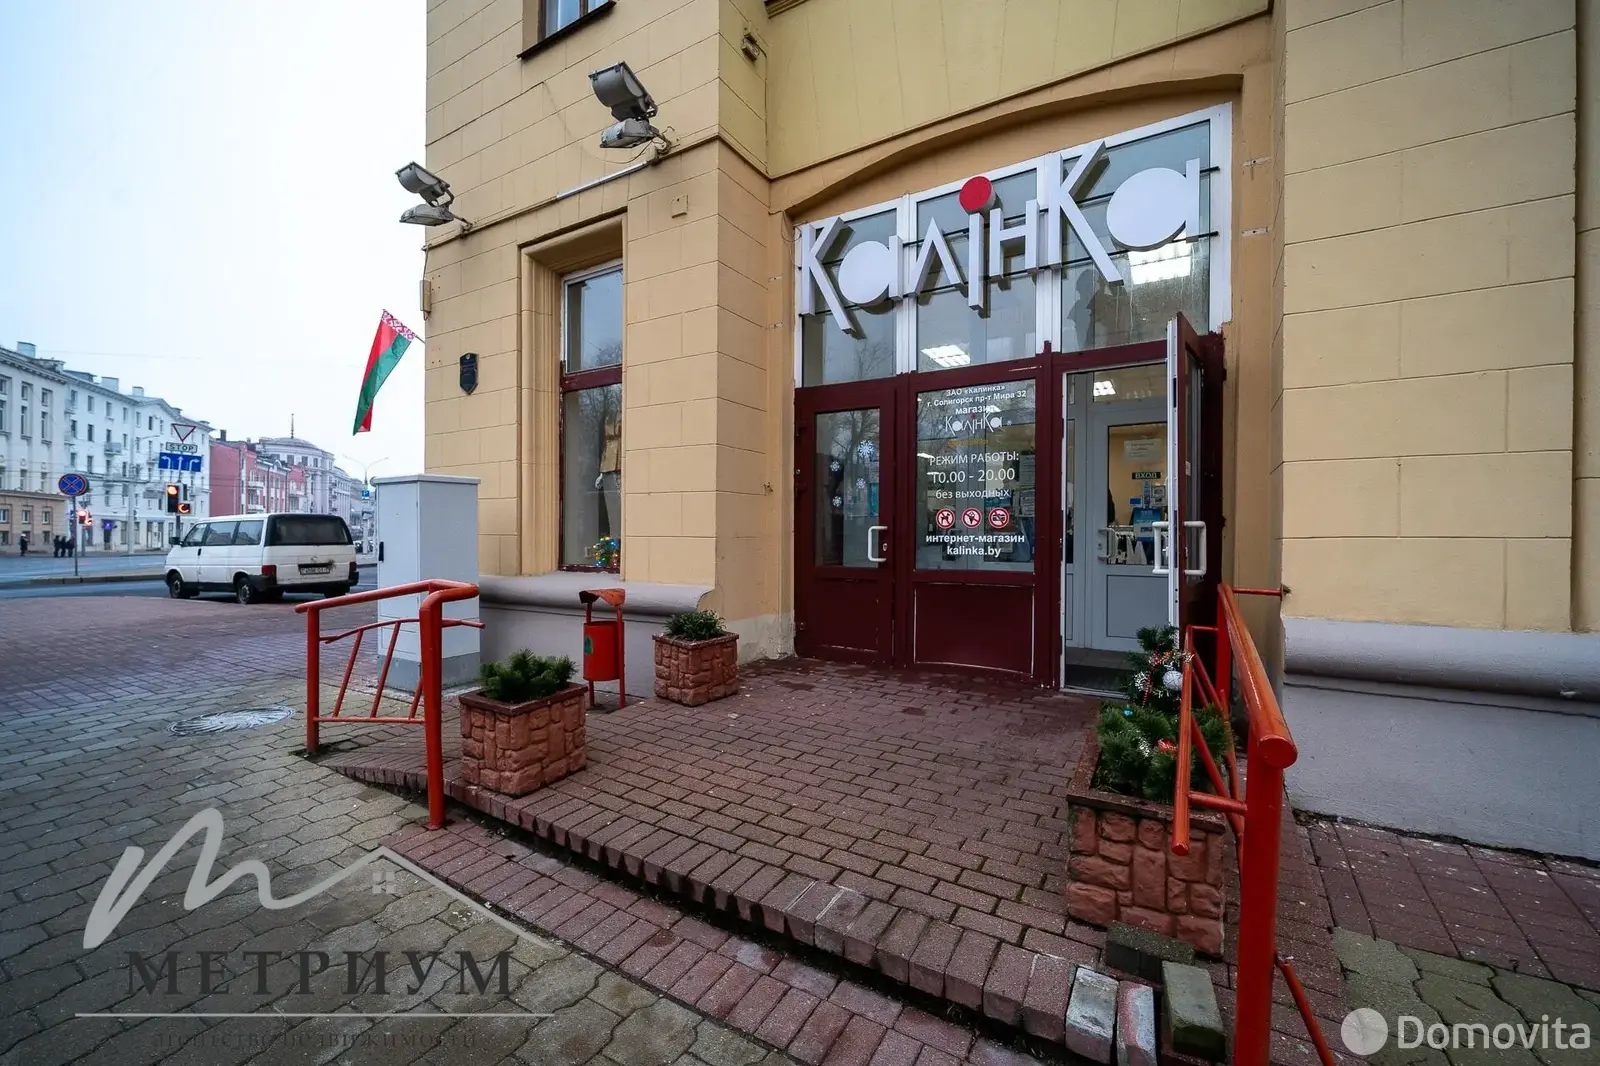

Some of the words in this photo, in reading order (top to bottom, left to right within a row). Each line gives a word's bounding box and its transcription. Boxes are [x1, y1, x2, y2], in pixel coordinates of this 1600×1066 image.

[946, 388, 962, 396] ЗАО
[933, 397, 974, 407] Солигорск
[975, 395, 991, 404] пр-т
[993, 392, 1015, 400] Мира
[1016, 390, 1027, 398] 32
[929, 454, 968, 466] РЕЖИМ
[970, 451, 1020, 463] РАБОТЫ:
[932, 470, 966, 484] 10.00
[978, 467, 1015, 482] 20.00
[935, 489, 953, 499] без
[955, 488, 1011, 500] выходных
[925, 534, 1025, 544] интернет-магазин
[946, 545, 1002, 557] kalinka.by
